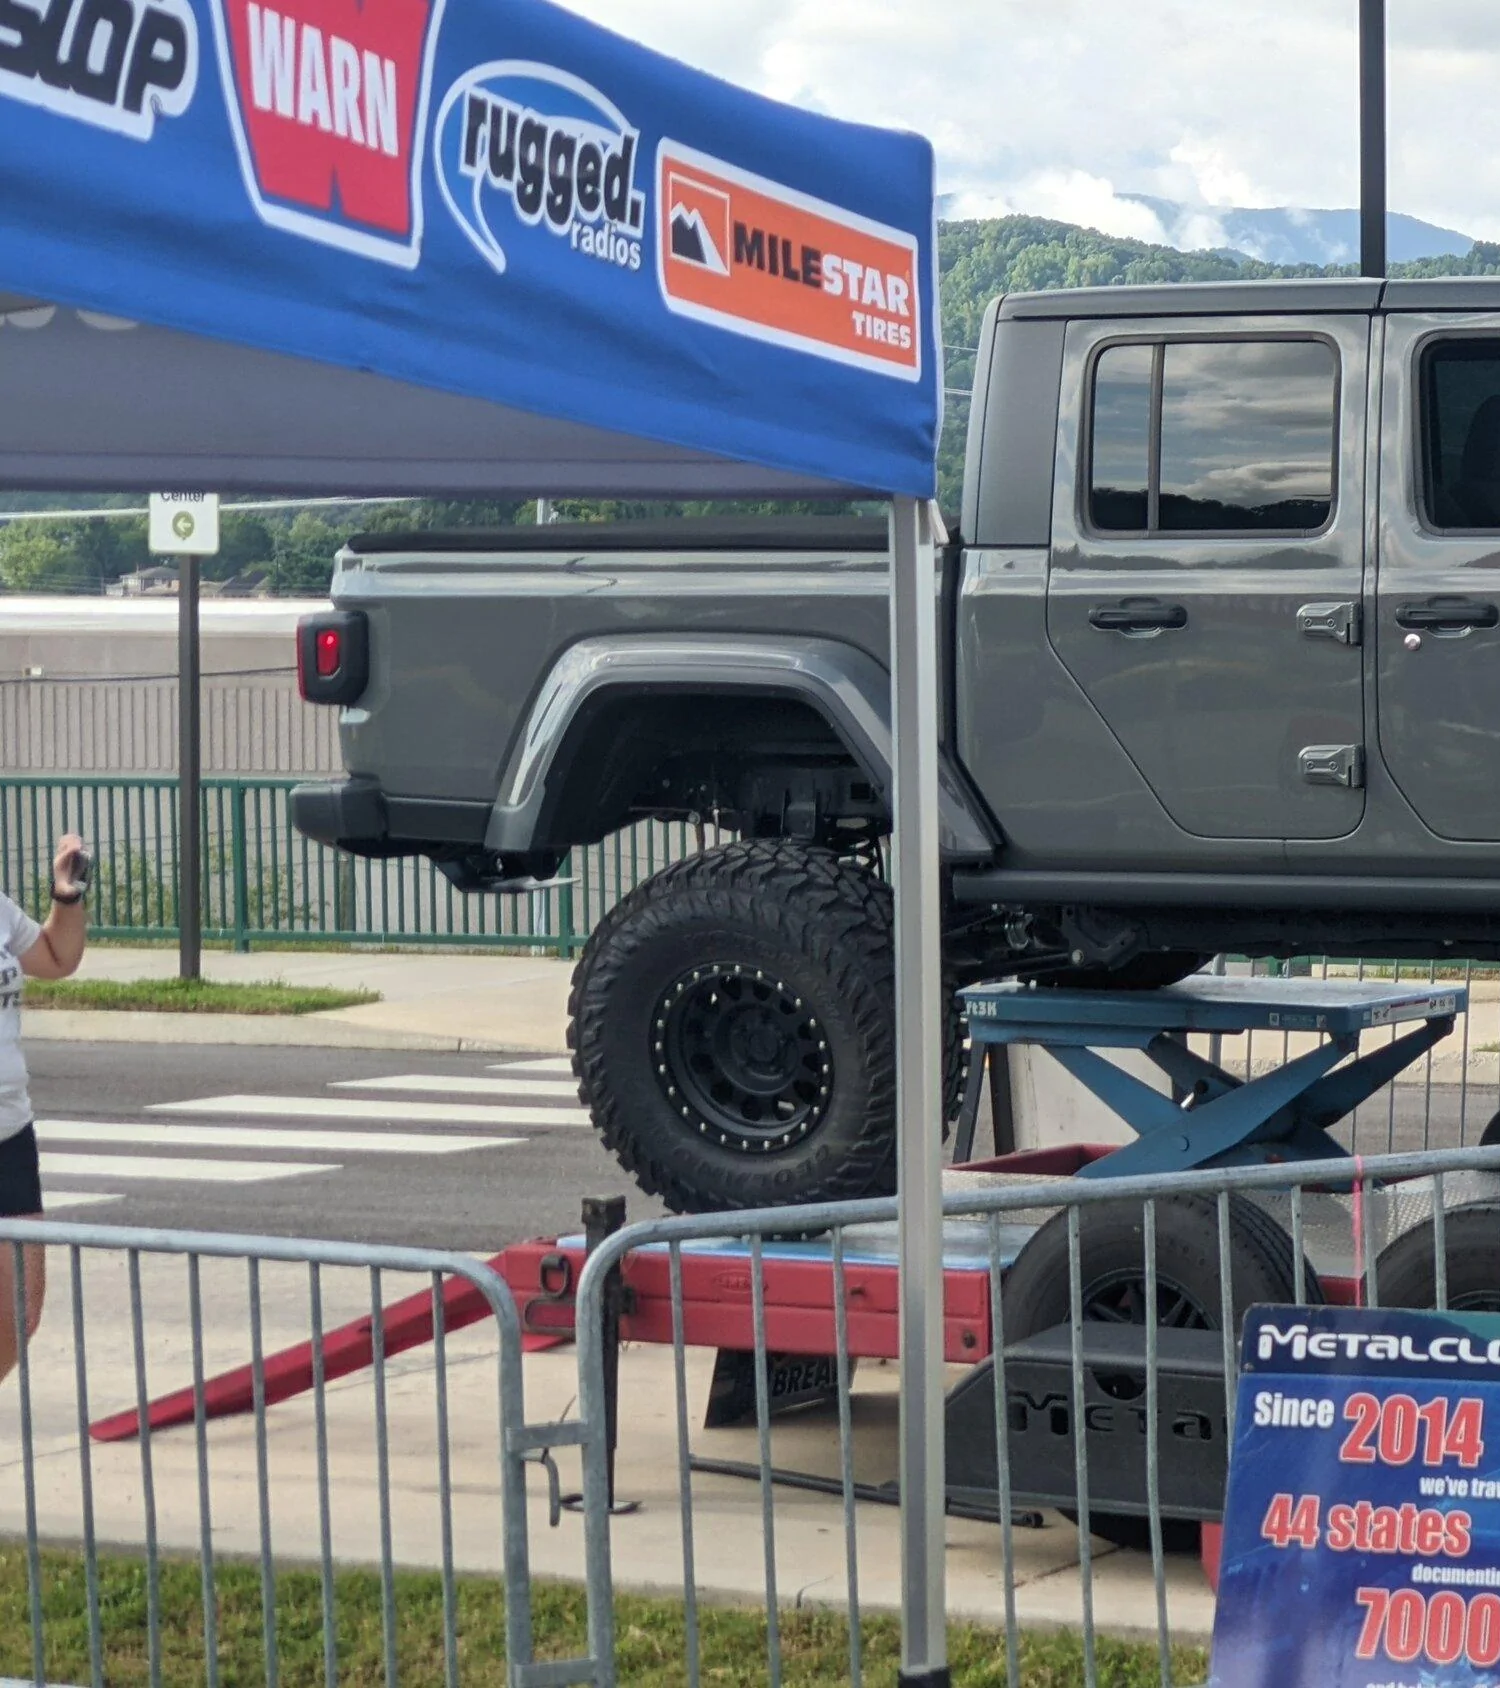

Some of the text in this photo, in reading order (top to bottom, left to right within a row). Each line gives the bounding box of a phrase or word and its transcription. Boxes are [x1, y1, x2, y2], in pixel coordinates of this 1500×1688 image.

[248, 2, 399, 158] WARN
[570, 219, 642, 271] radios
[733, 220, 909, 317] MILESTAR
[852, 310, 912, 349] TIRES
[1253, 1391, 1484, 1467] Since 2014
[1419, 1476, 1469, 1497] we've
[1261, 1493, 1472, 1557] 44 states
